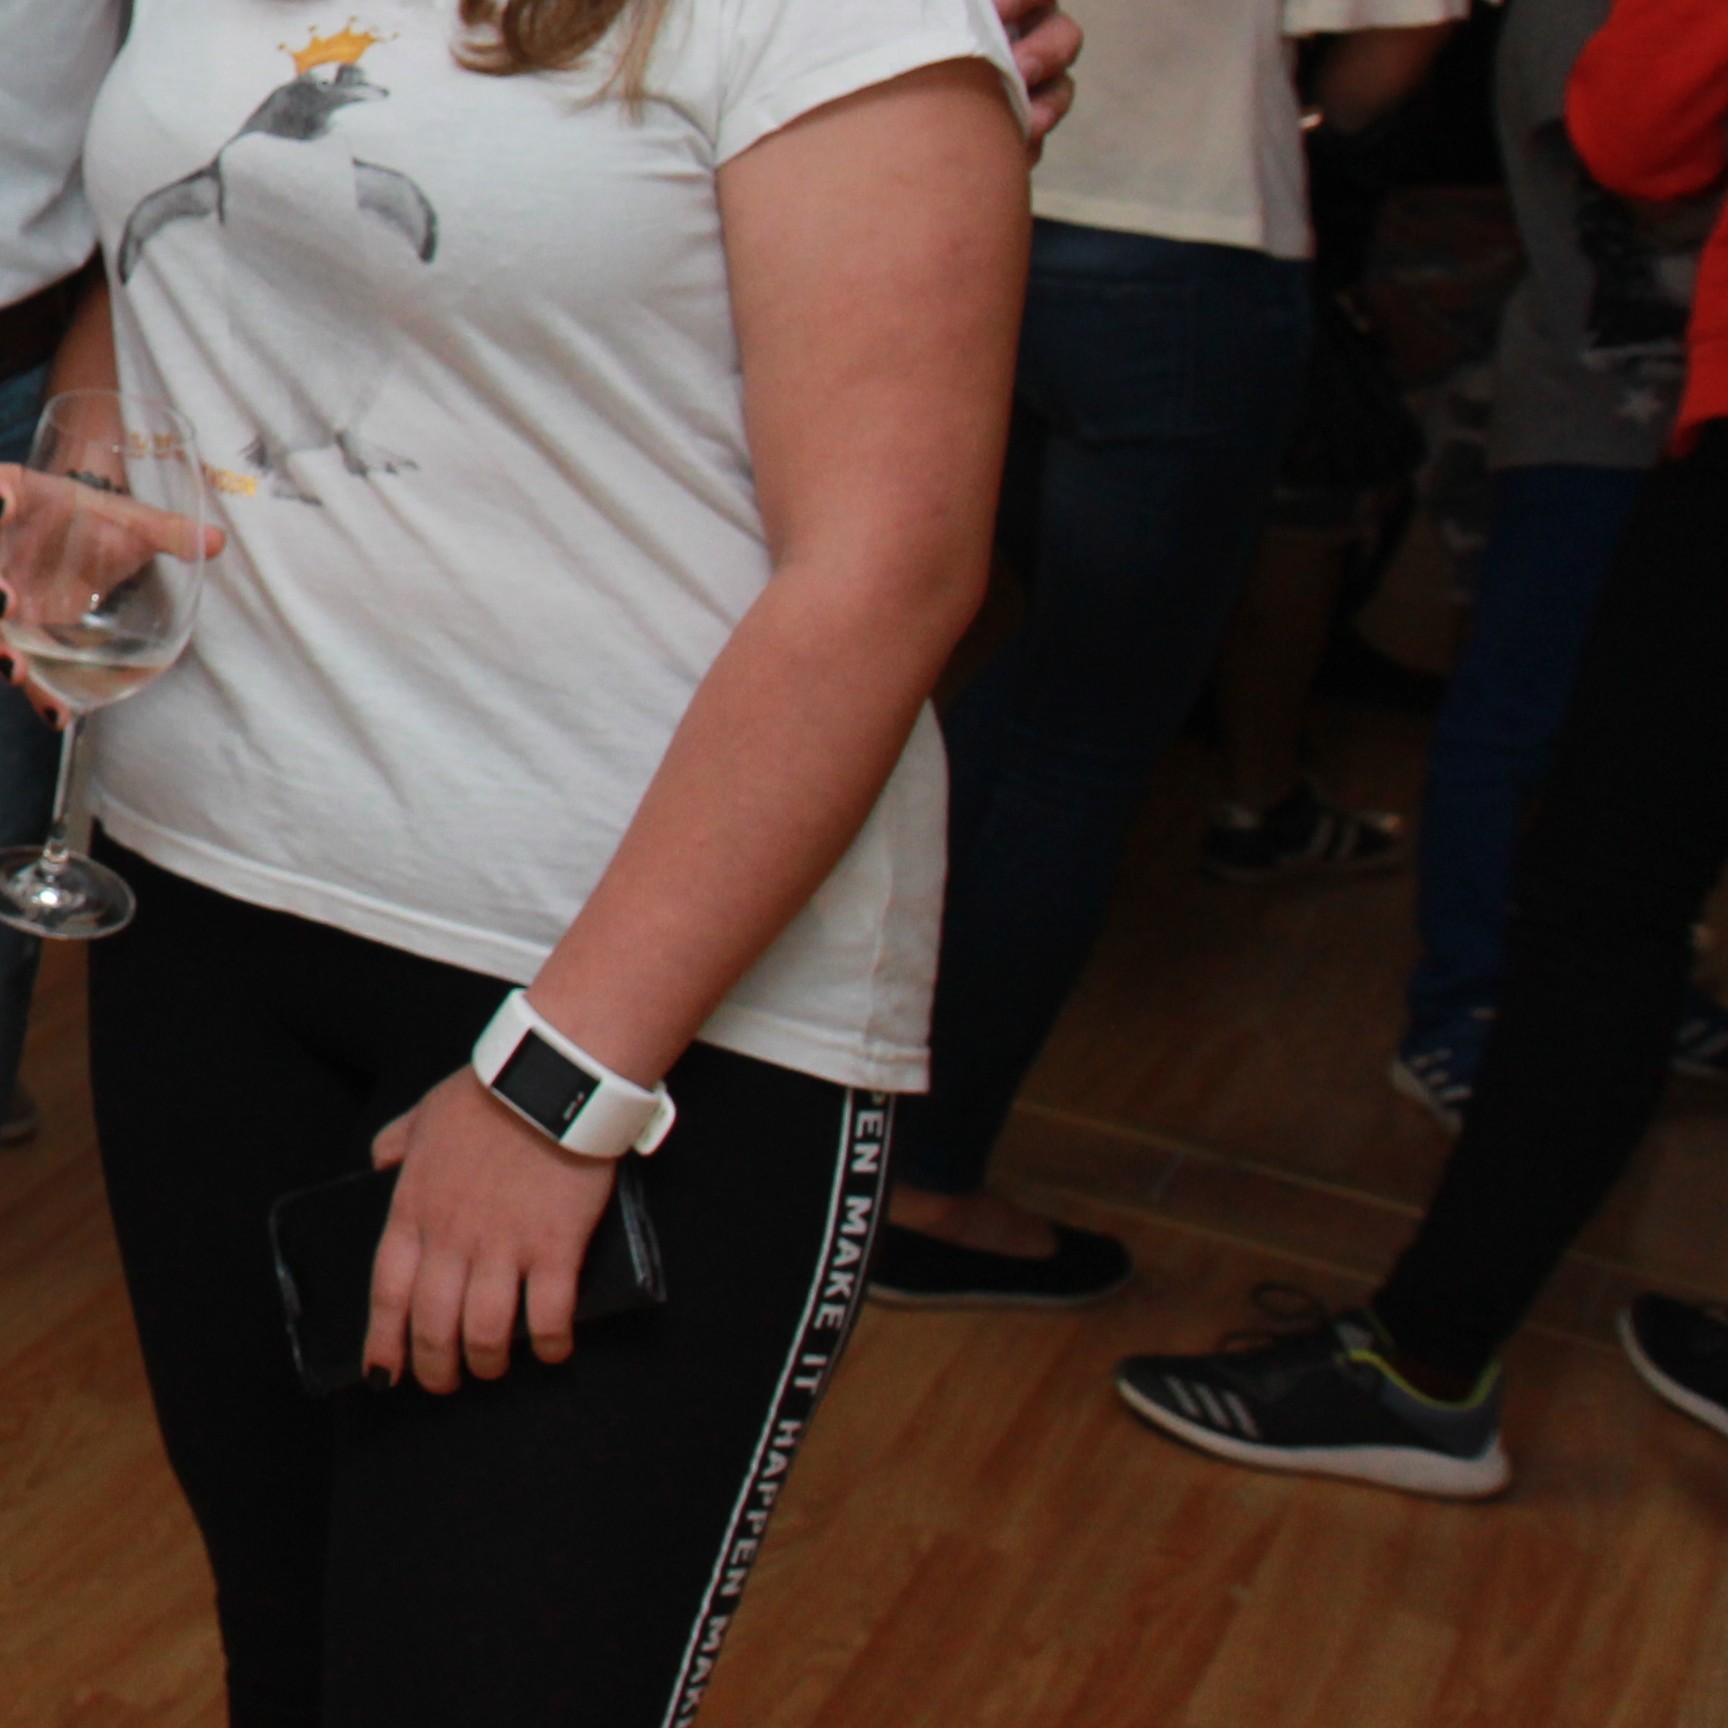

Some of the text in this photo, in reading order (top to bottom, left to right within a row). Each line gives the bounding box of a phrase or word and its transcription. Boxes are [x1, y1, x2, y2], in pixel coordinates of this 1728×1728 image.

[814, 1194, 873, 1330] MAKE
[793, 1352, 828, 1396] IT
[720, 1418, 802, 1598] HAPPEN
